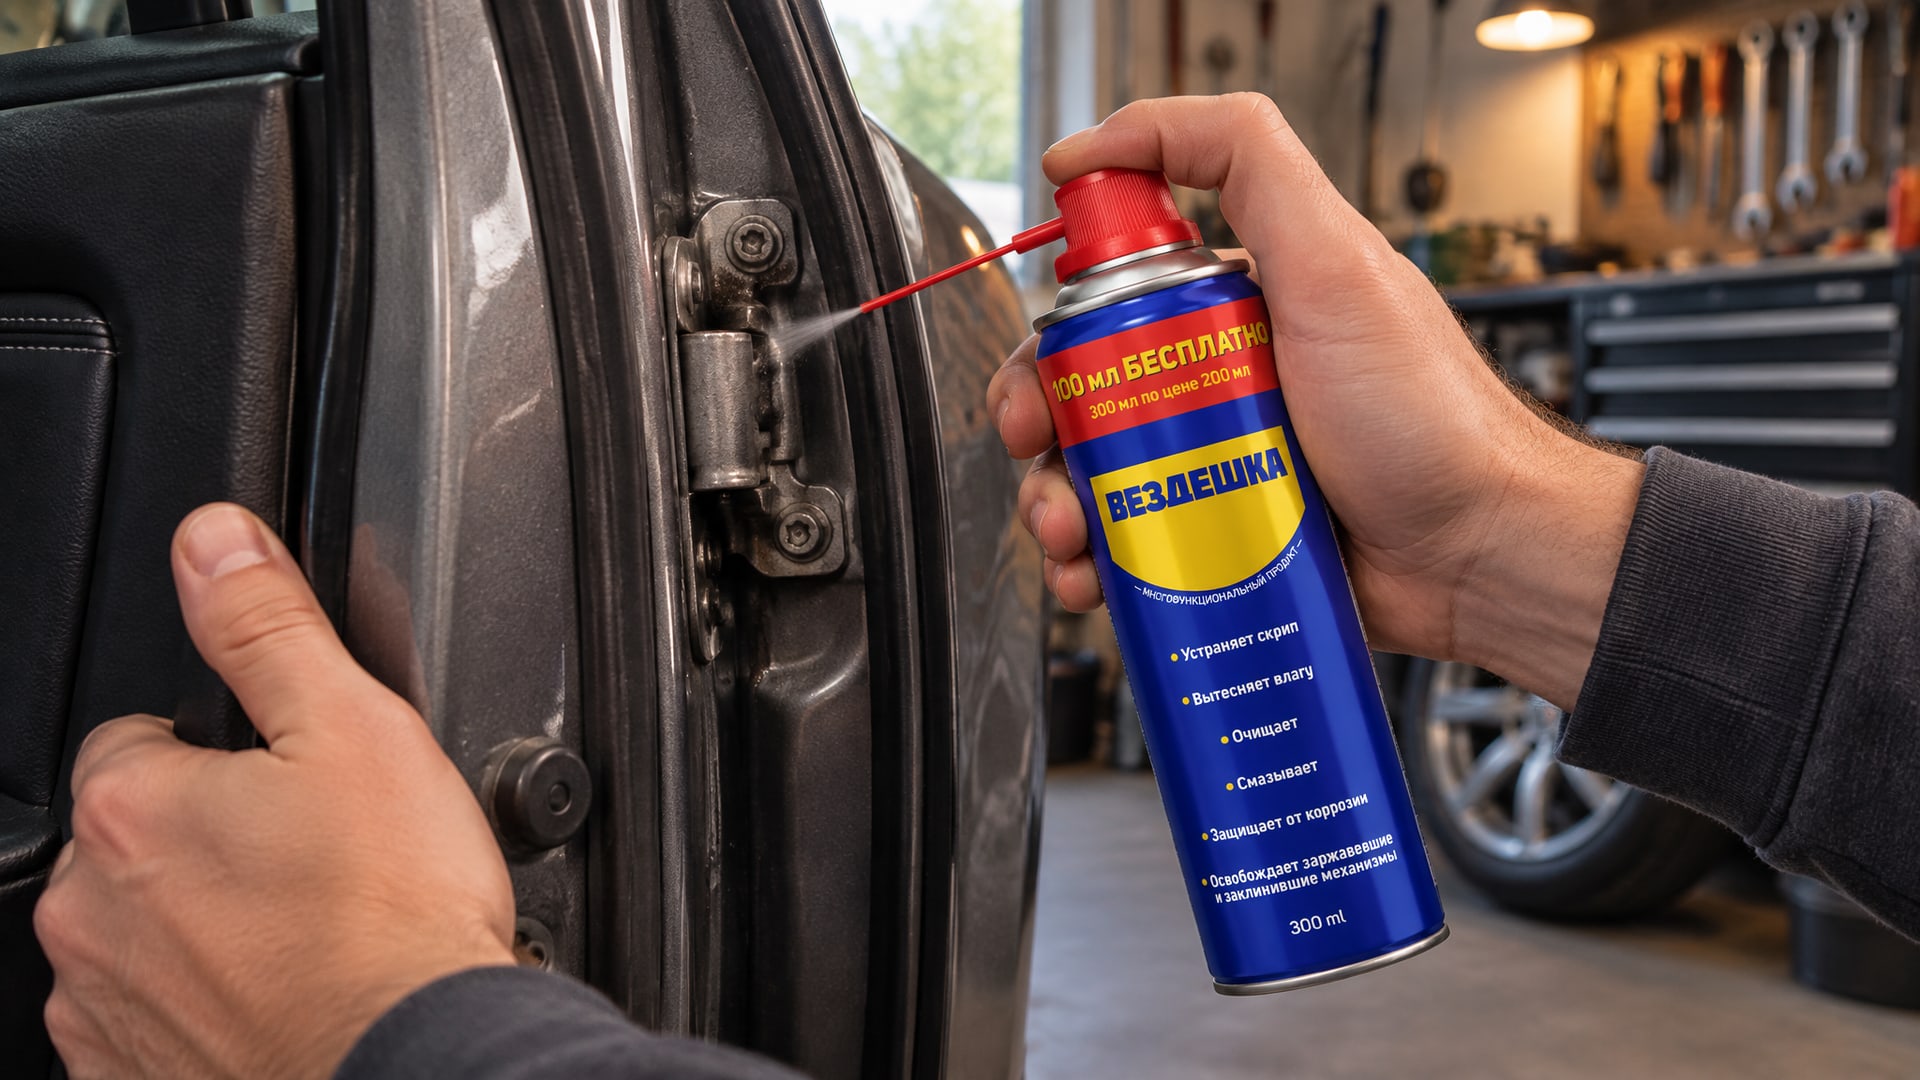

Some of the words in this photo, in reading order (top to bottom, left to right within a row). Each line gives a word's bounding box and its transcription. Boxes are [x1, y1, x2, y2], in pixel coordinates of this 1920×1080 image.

[1052, 373, 1084, 403] 100
[1087, 367, 1121, 392] мл
[1122, 321, 1270, 381] БЕСПЛАТНО
[1089, 400, 1116, 420] 300
[1118, 396, 1140, 411] мл
[1141, 391, 1160, 405] по
[1162, 379, 1199, 400] цене
[1201, 368, 1230, 388] 200
[1232, 365, 1251, 379] мл
[1105, 447, 1288, 523] ВЕЗДЕШКА
[1181, 634, 1254, 661] Устраняет
[1257, 621, 1299, 641] скрип
[1192, 677, 1270, 706] Вытесняет
[1273, 665, 1314, 686] влагу
[1232, 718, 1298, 743] Очищает
[1236, 760, 1318, 790] Смазывает
[1210, 818, 1282, 842] Защищает
[1285, 813, 1302, 826] от
[1305, 793, 1369, 821] коррозии
[1210, 861, 1299, 888] Освобождает
[1302, 833, 1393, 869] заржавевшие
[1215, 893, 1223, 904] и
[1225, 874, 1318, 903] заклинившие
[1321, 850, 1398, 882] механизмы
[1289, 915, 1323, 935] 300
[1326, 909, 1347, 926] ml
